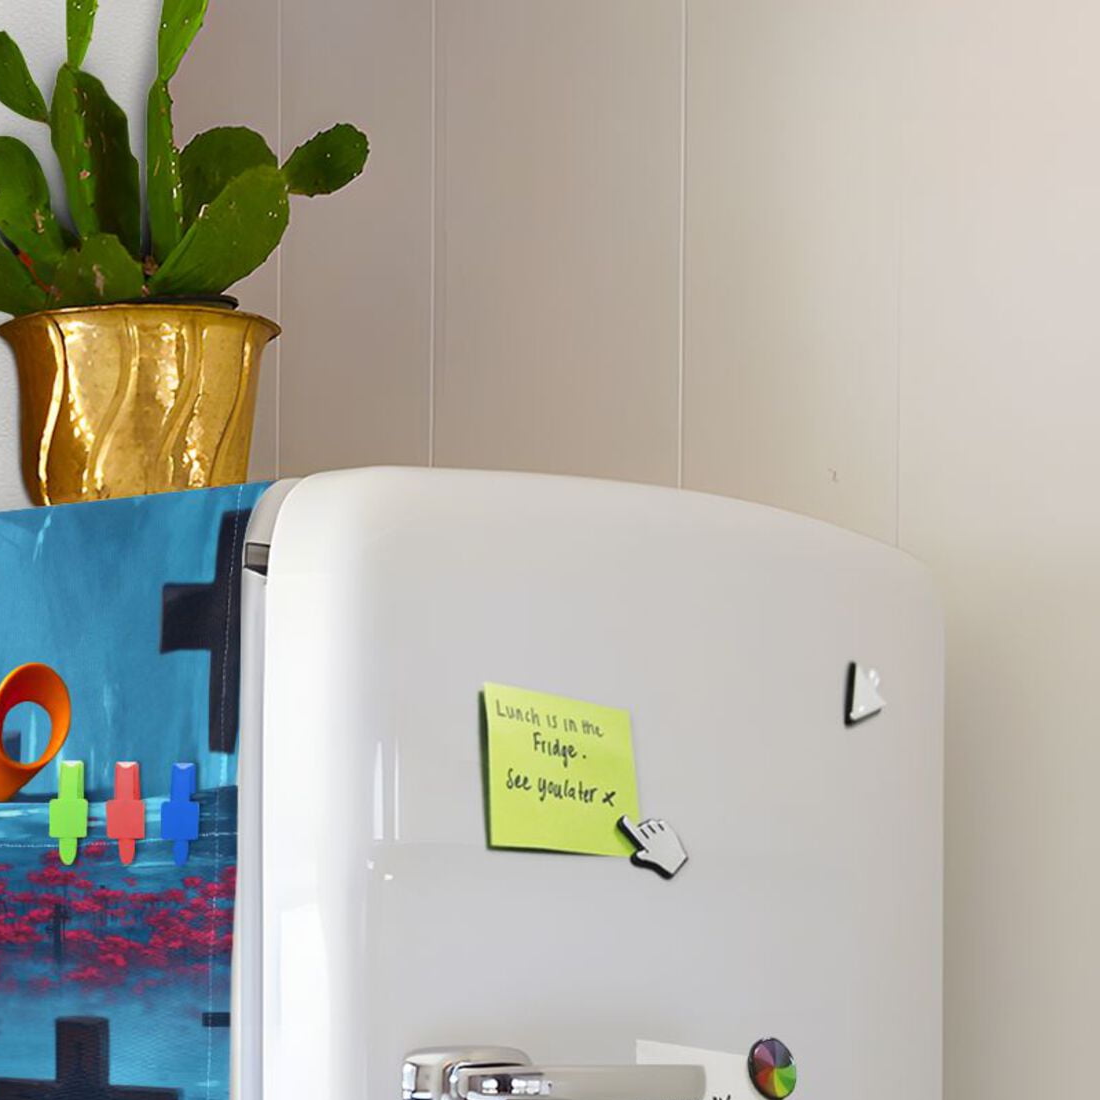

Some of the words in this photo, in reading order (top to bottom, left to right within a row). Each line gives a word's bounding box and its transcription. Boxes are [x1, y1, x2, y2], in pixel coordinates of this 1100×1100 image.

[496, 699, 540, 727] Lunch
[582, 720, 604, 738] the
[506, 768, 532, 790] See
